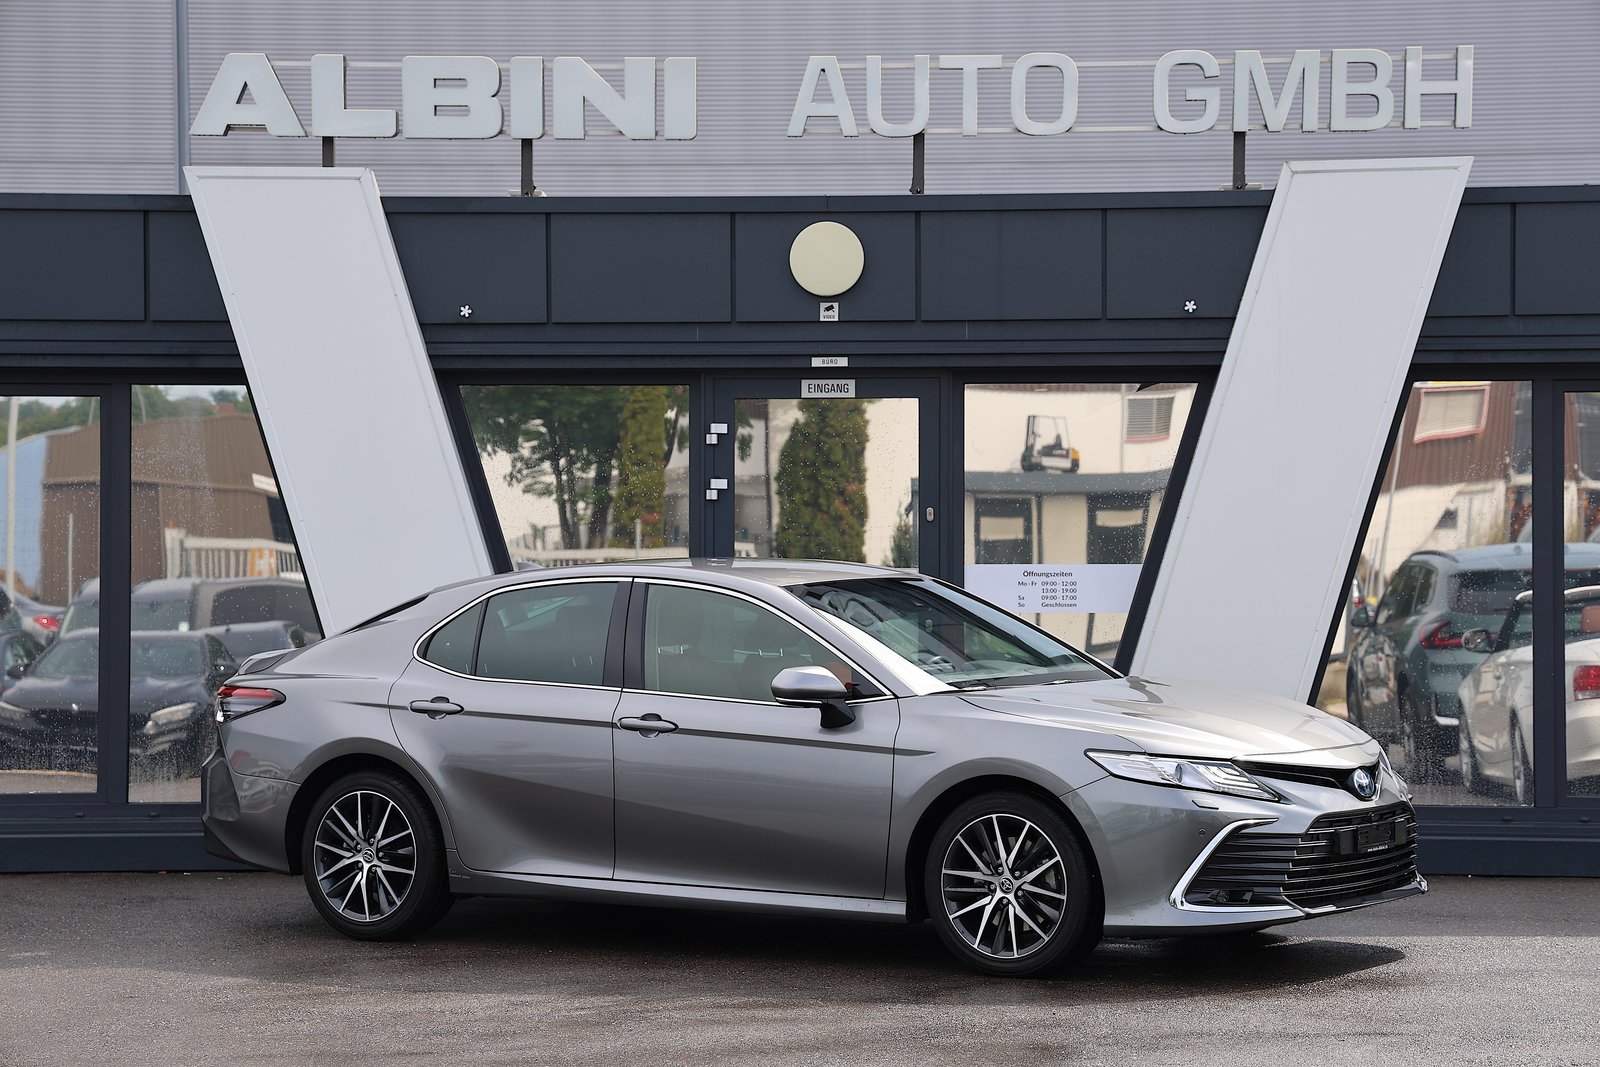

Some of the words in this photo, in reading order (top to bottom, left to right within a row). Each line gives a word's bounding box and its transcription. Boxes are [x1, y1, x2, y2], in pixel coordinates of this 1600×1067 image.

[189, 53, 697, 140] ALBINI
[787, 52, 1079, 137] AUTO
[1153, 45, 1474, 135] GMBH
[808, 383, 849, 393] EINGANG
[1023, 570, 1073, 578] Öffnungszeiten
